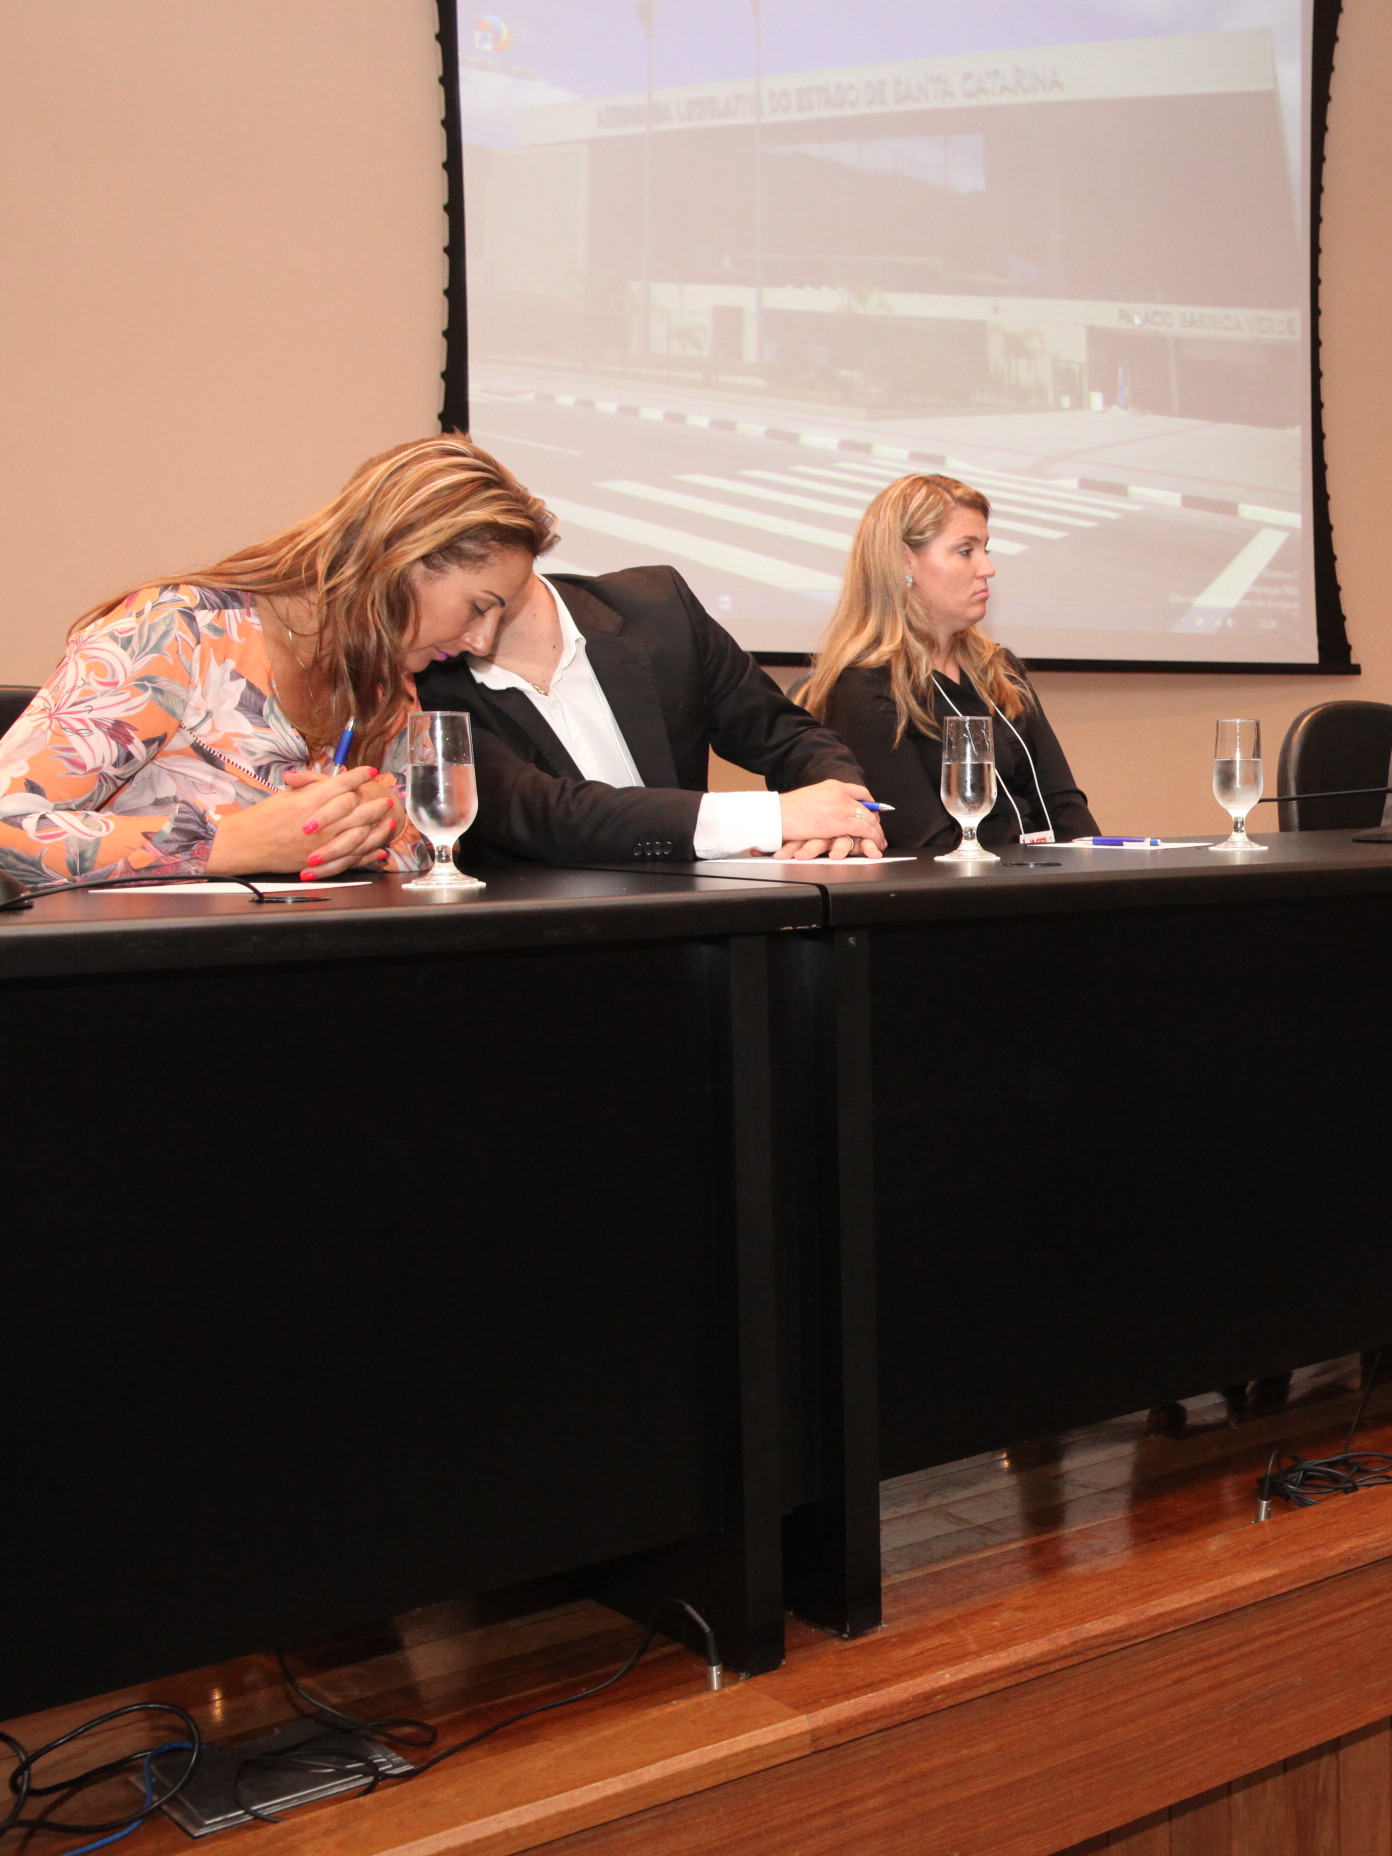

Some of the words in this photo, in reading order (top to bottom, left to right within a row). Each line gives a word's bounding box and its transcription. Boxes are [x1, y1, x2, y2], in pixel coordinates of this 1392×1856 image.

[769, 89, 791, 114] DO
[795, 82, 858, 112] ESTADO
[865, 77, 887, 107] DE
[893, 73, 954, 105] SANTA
[960, 62, 1064, 99] CATARINA
[1180, 312, 1243, 332] BARRIGA
[1243, 316, 1297, 336] VERDE
